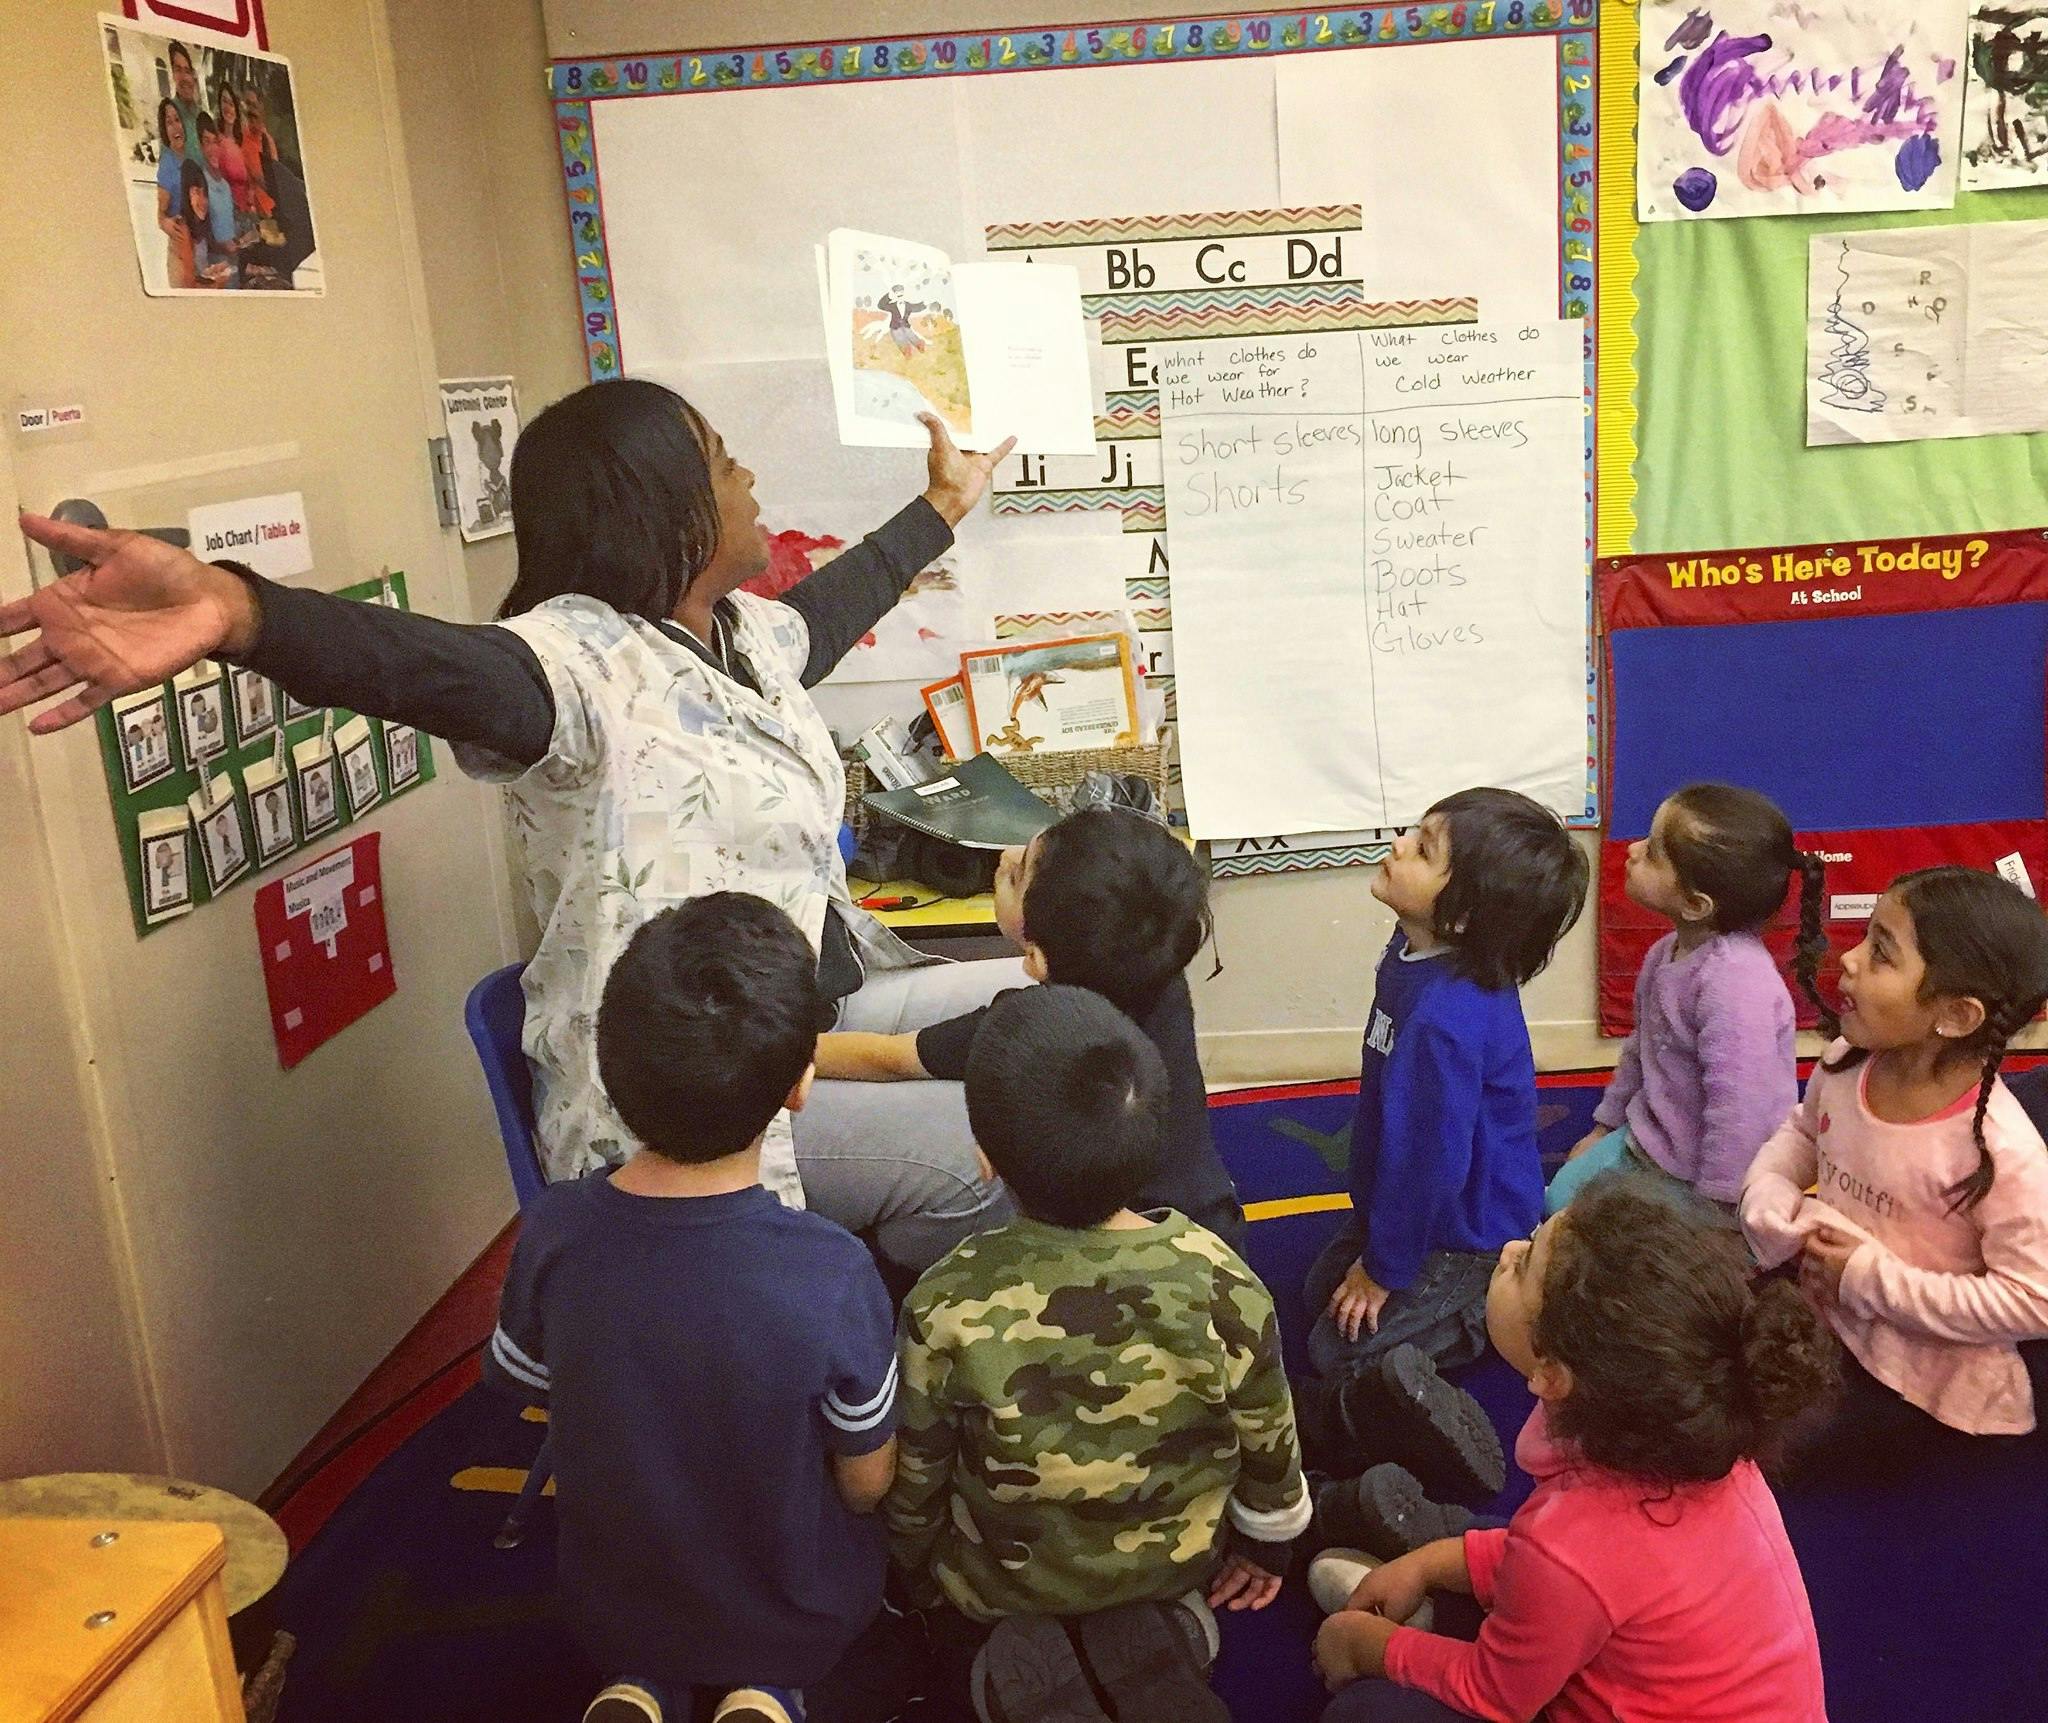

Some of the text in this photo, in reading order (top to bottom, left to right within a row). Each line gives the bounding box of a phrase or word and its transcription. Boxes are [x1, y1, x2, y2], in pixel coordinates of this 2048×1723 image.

[567, 66, 583, 90] 8
[623, 62, 648, 84] 10
[689, 57, 706, 82] 2
[731, 54, 745, 77] 3
[775, 50, 792, 74] 5
[819, 46, 833, 71] 6
[847, 46, 862, 69] 7
[873, 45, 889, 69] 8
[931, 40, 957, 64] 10
[981, 38, 991, 62] 1
[998, 36, 1016, 62] 2
[1040, 33, 1056, 58] 3
[1086, 29, 1104, 54] 5
[1132, 26, 1147, 51] 6
[1161, 24, 1176, 49] 7
[1187, 24, 1204, 49] 8
[1225, 20, 1242, 43] 9
[1246, 20, 1271, 43] 10
[1297, 16, 1307, 41] 1
[1315, 15, 1333, 39] 2
[1358, 11, 1374, 35] 3
[1405, 7, 1422, 32] 5
[1452, 3, 1467, 28] 6
[1481, 1, 1497, 25] 7
[1507, 0, 1524, 25] 8
[1567, 0, 1593, 19] 10
[1569, 74, 1591, 93] 2
[1569, 120, 1591, 136] 3
[564, 161, 586, 177] 5
[1570, 171, 1591, 187] 5
[578, 252, 600, 269] 2
[1107, 237, 1342, 289] Bb Cc Dd
[1571, 248, 1592, 262] 7
[1570, 275, 1591, 291] 8
[587, 312, 606, 337] 10
[1370, 333, 1417, 347] What
[1518, 326, 1540, 341] do
[1297, 343, 1317, 360] do
[1375, 354, 1469, 367] we wear
[1166, 365, 1280, 386] we wear for
[1395, 367, 1537, 393] Cold Weather
[1171, 388, 1204, 410] Hot
[20, 414, 43, 427] Door
[1179, 425, 1262, 465] Short
[1371, 419, 1422, 460] long
[1101, 445, 1144, 491] Jj
[1373, 460, 1468, 491] Jacket
[1184, 464, 1310, 517] Shorts
[1374, 486, 1454, 522] Coat
[205, 532, 224, 551] Job
[225, 529, 253, 547] Chart
[261, 523, 287, 541] Tabla
[289, 519, 301, 535] de
[1372, 521, 1488, 555] Sweater
[1371, 553, 1467, 596] Boots
[1667, 539, 1989, 589] Who's Here Today?
[1377, 590, 1428, 621] Hat
[1790, 585, 1862, 605] At School
[1372, 622, 1484, 655] Gloves
